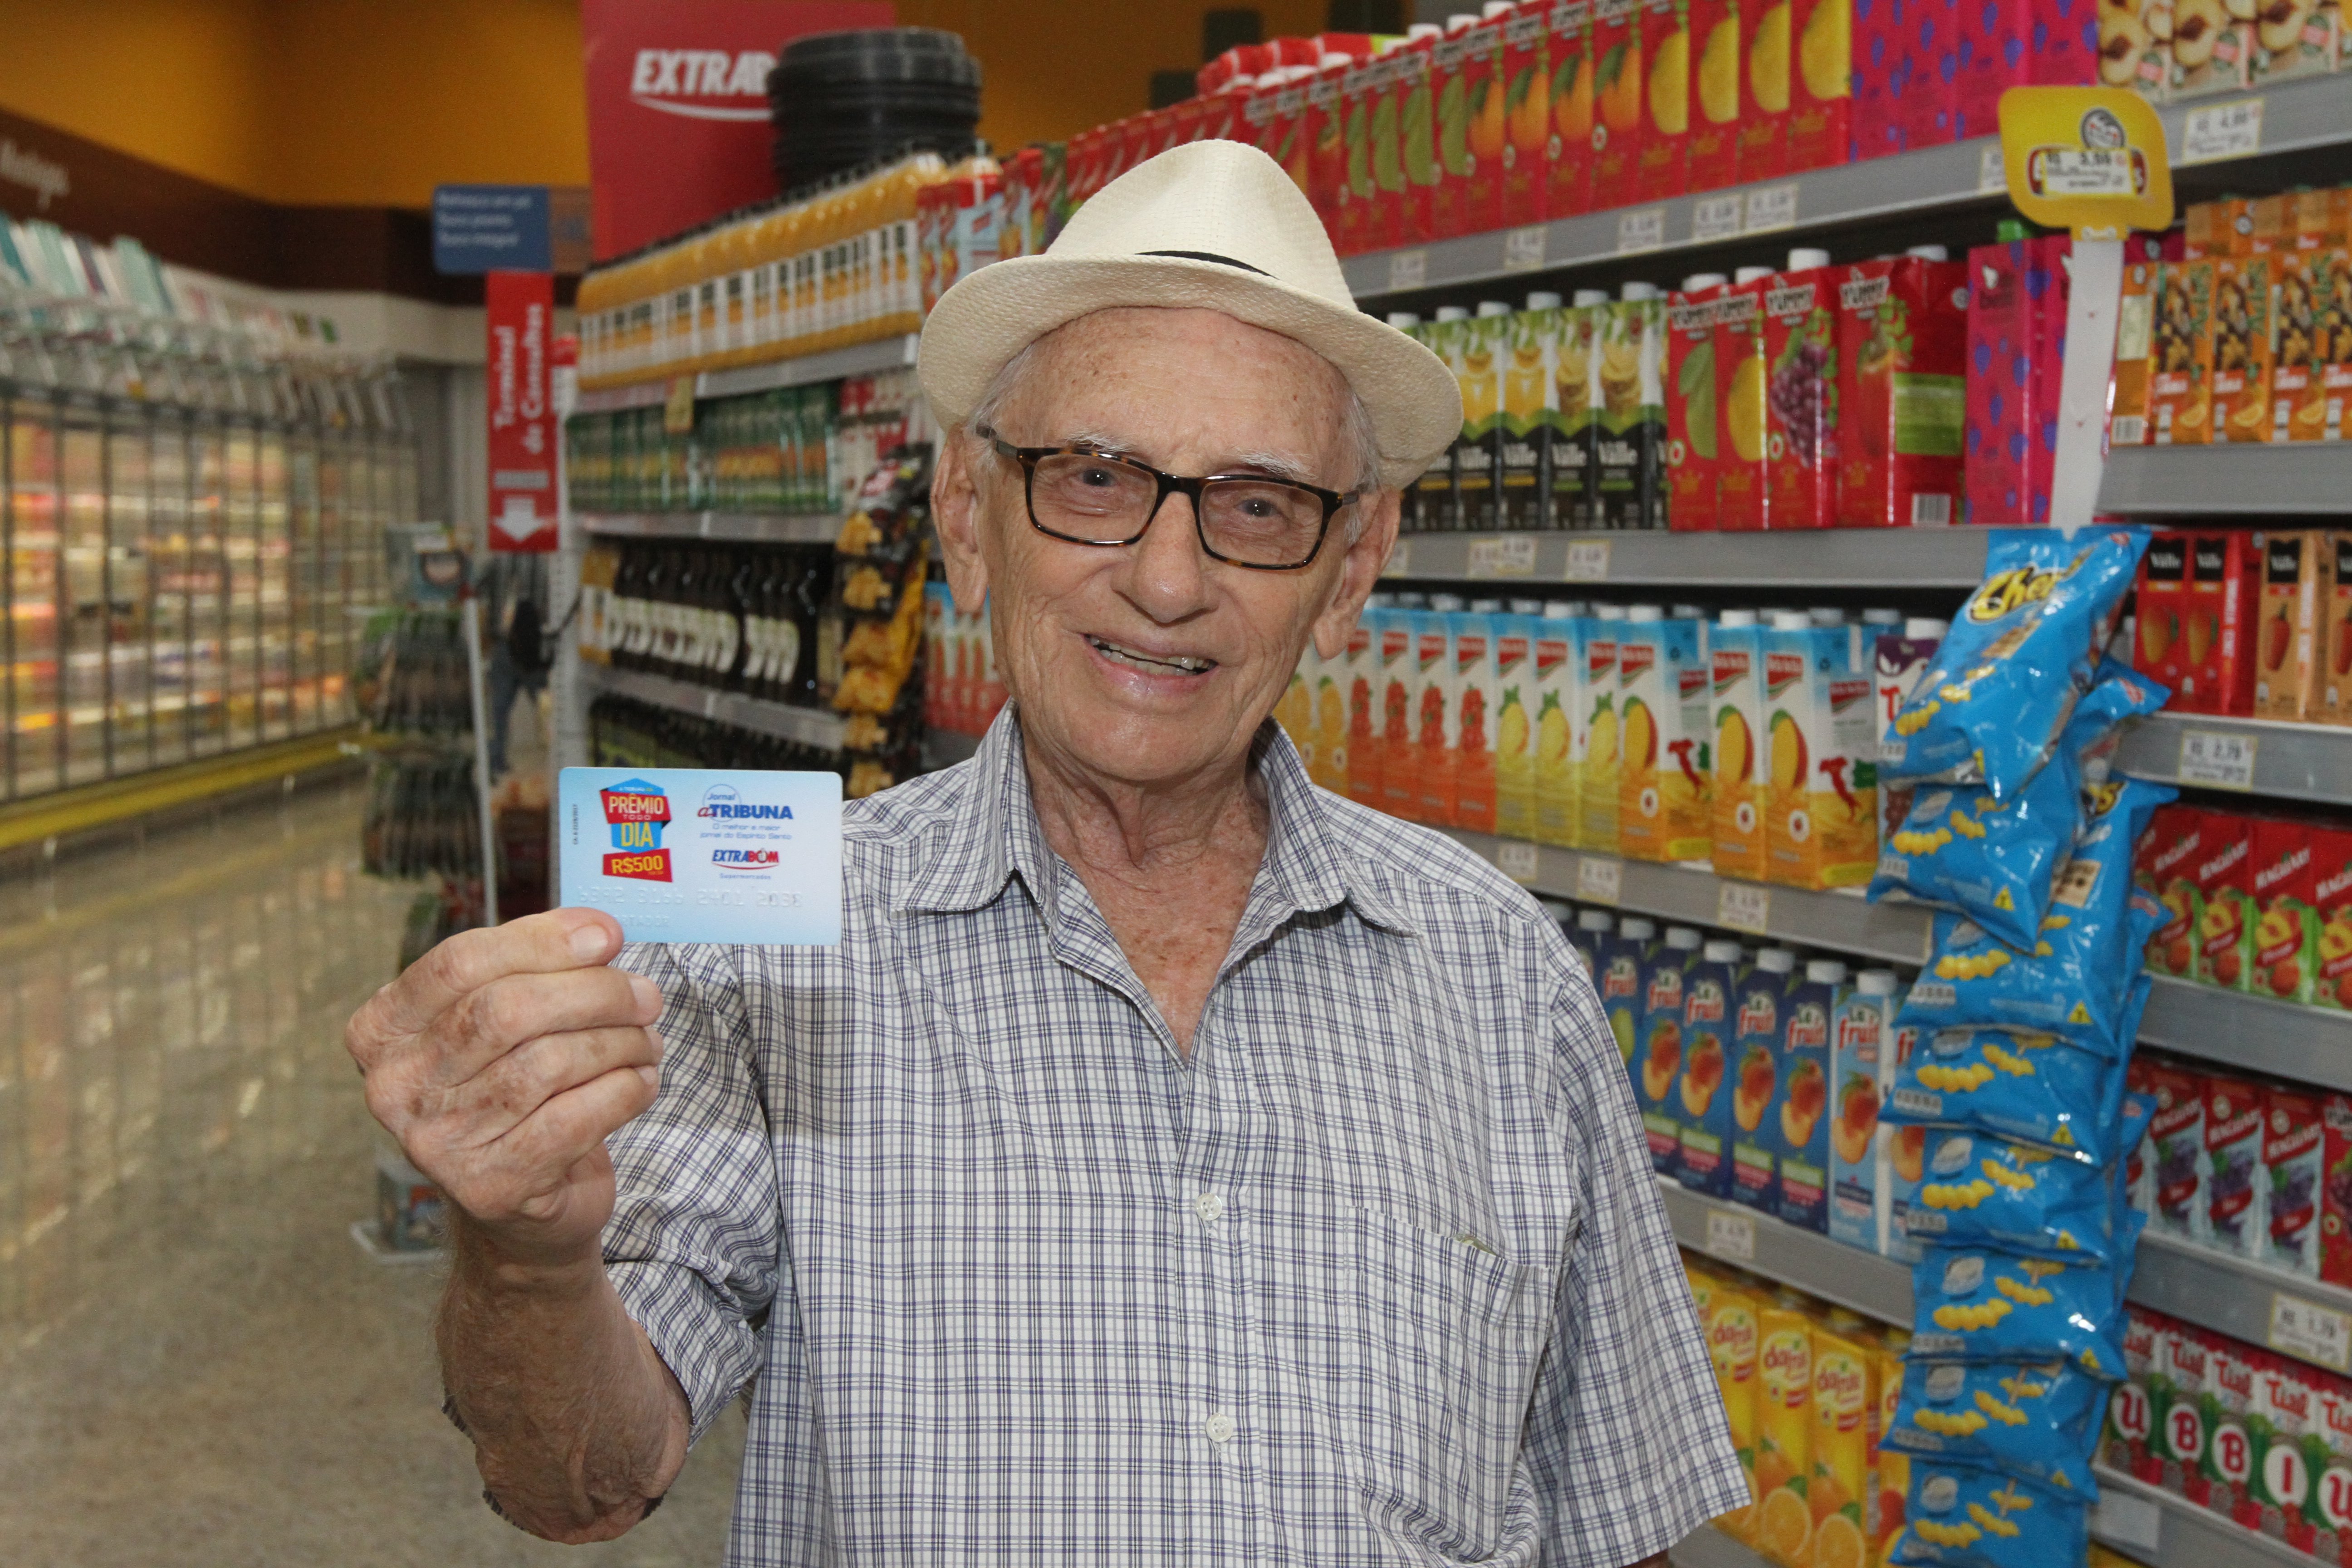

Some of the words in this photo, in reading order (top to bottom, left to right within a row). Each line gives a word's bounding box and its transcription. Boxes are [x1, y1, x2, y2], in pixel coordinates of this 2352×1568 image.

[632, 49, 776, 95] EXTRAB
[608, 793, 664, 814] PRÊMIO
[621, 822, 654, 847] DIA
[611, 855, 663, 874] R$500
[1785, 1017, 1826, 1053] fruit
[1838, 1018, 1880, 1050] fruit
[2174, 1412, 2198, 1452] B
[2220, 1431, 2245, 1475] B
